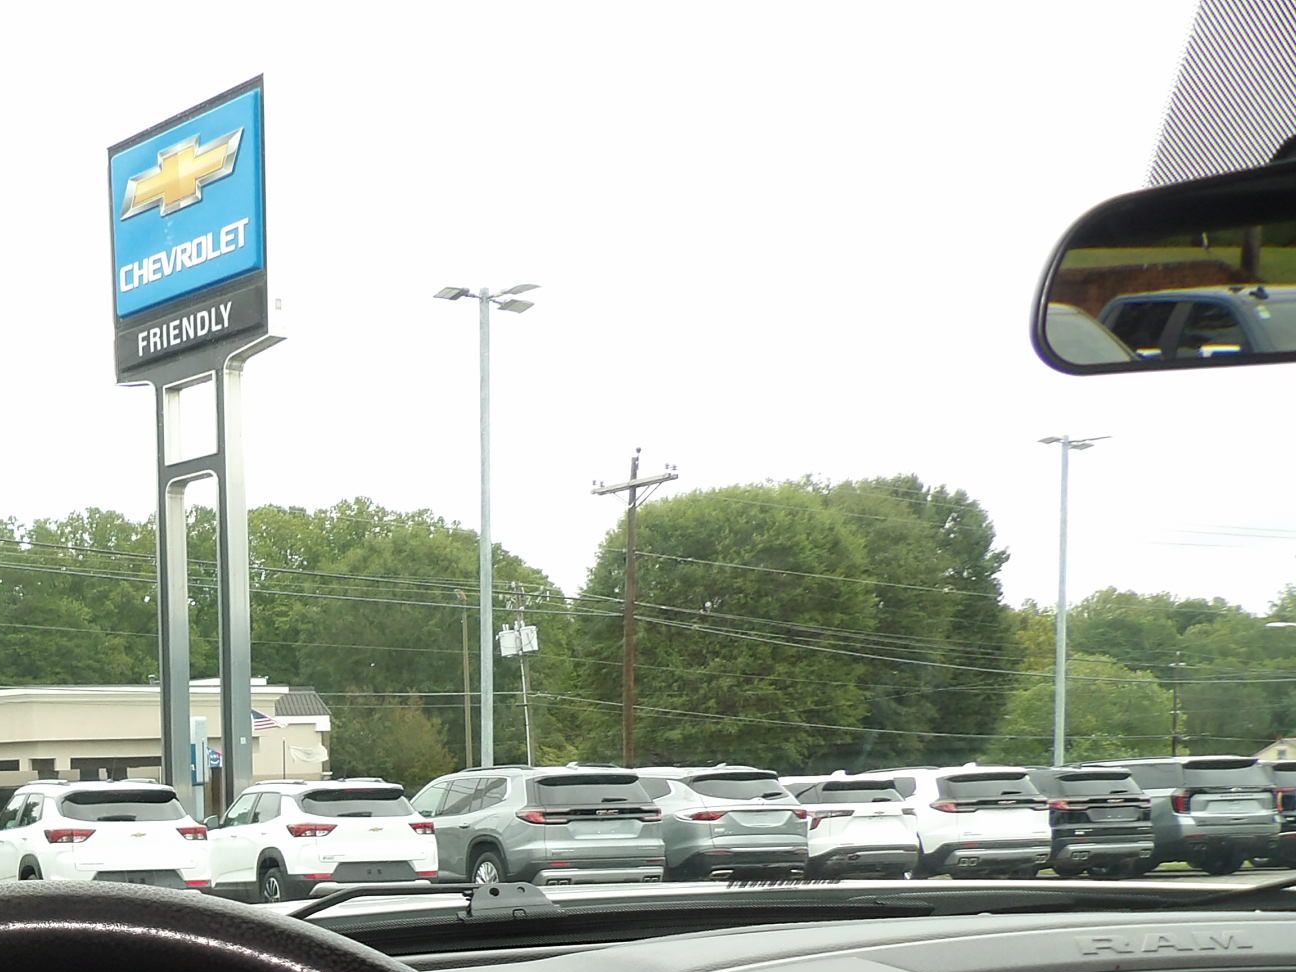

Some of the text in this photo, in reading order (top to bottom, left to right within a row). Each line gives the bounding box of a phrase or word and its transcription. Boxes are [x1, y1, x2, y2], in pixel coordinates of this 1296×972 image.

[119, 217, 249, 293] CHEVROLET
[137, 300, 232, 357] FRIENDLY
[1075, 929, 1254, 956] RAM
